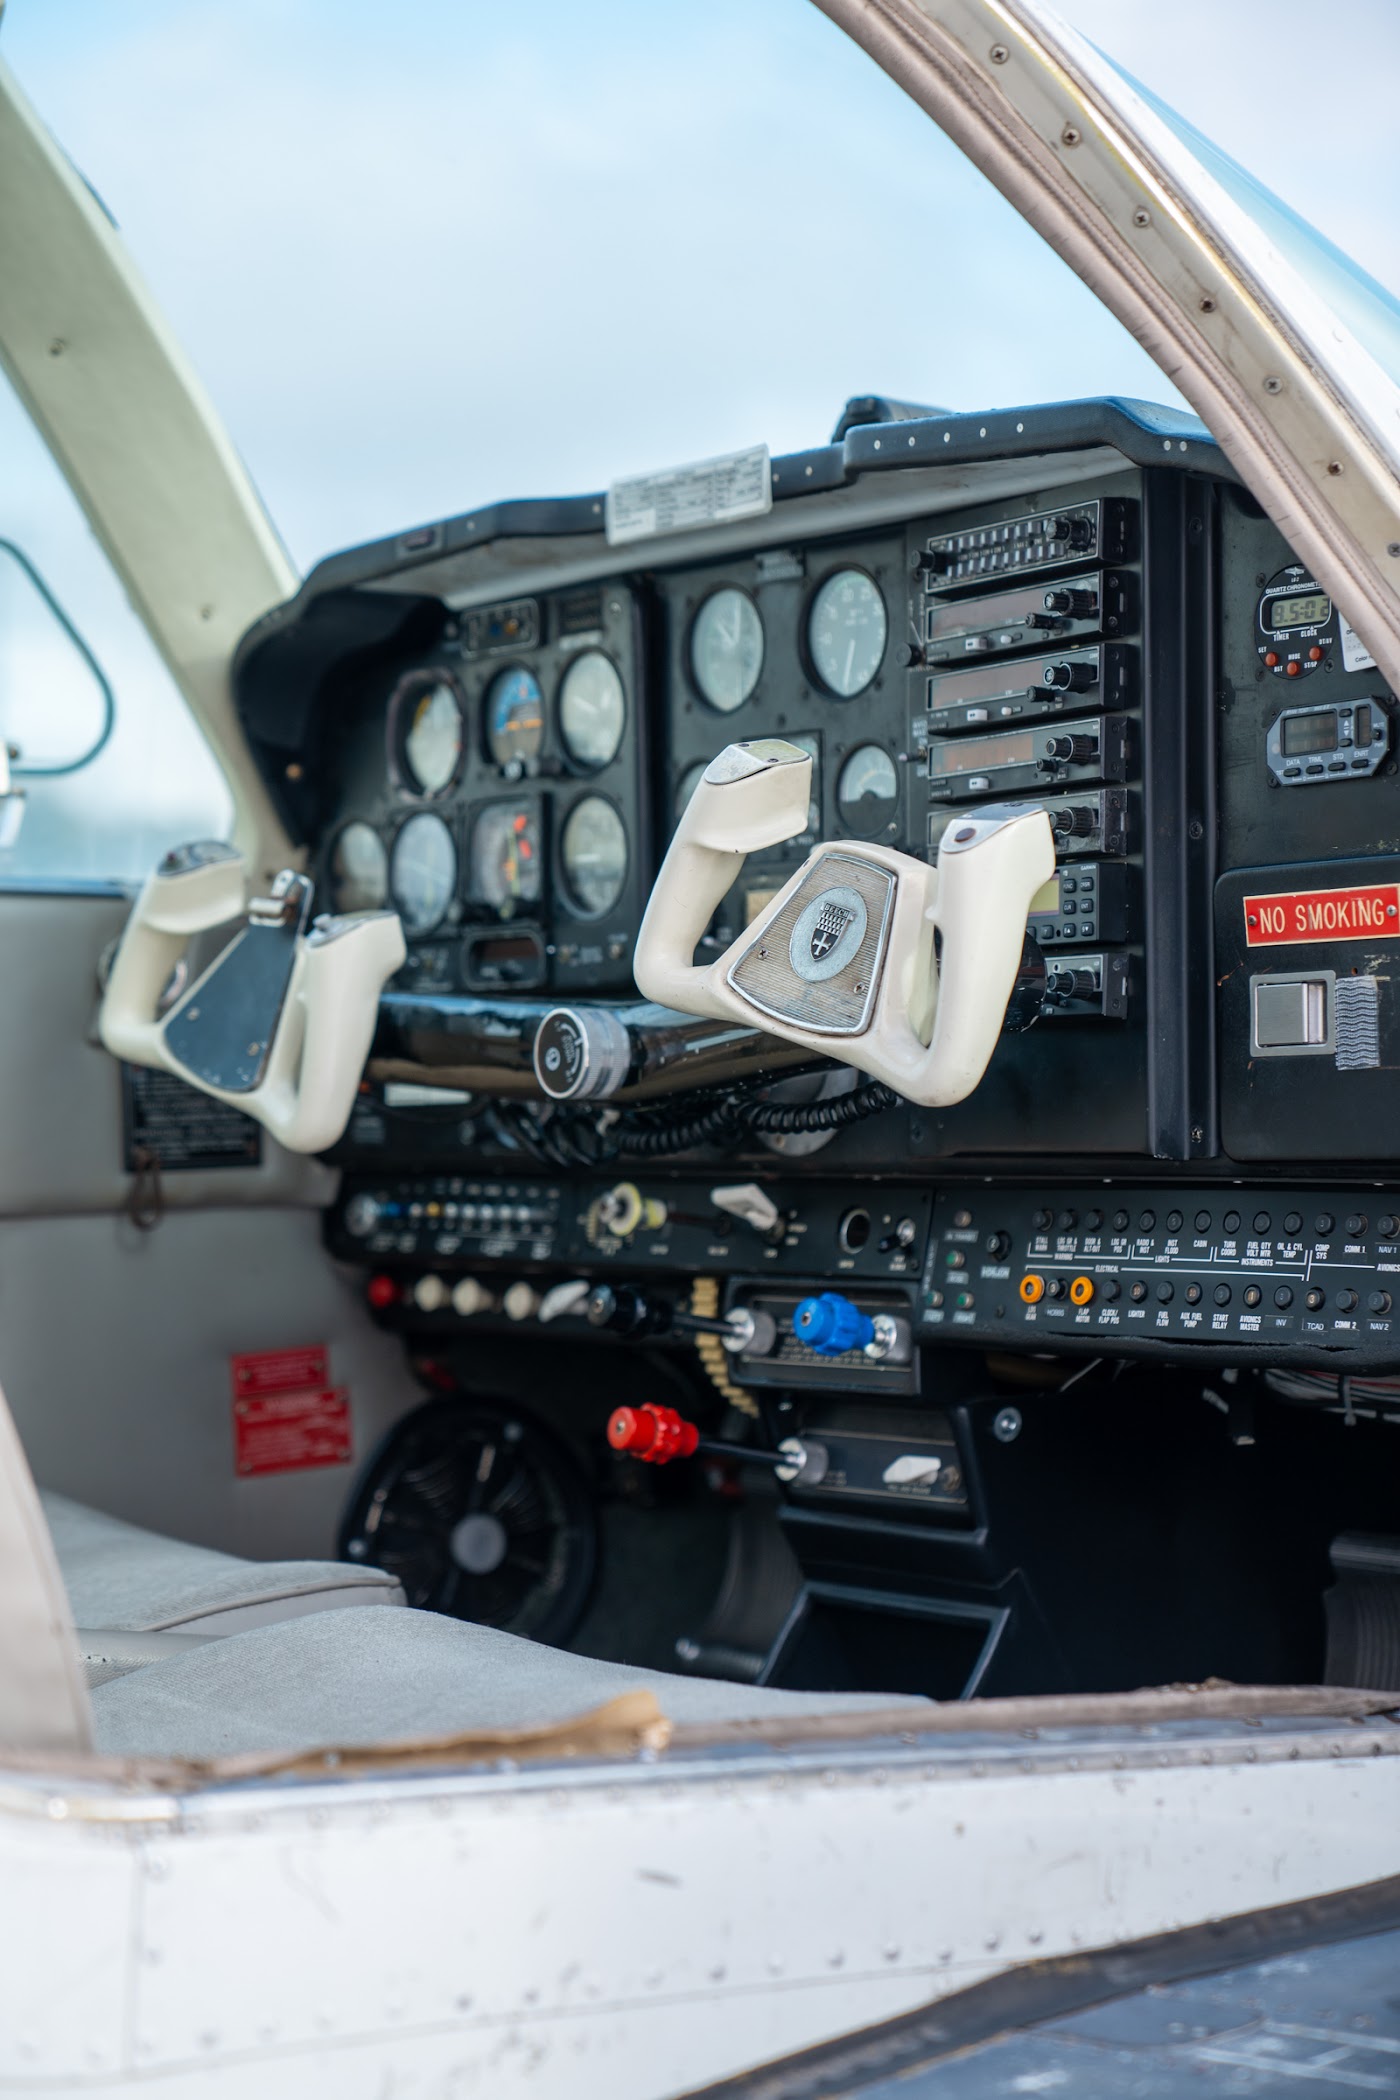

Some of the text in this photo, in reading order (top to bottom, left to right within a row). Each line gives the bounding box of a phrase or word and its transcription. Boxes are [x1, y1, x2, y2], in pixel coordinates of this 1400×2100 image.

[1265, 584, 1287, 594] QUARTZ
[1273, 633, 1289, 641] TIMER
[1300, 629, 1318, 638] CLOCK
[1258, 646, 1267, 654] SET
[1274, 665, 1283, 673] RST
[1333, 753, 1344, 761] STD
[1354, 749, 1369, 758] ENRT
[1286, 759, 1300, 767] DATA
[1308, 756, 1323, 764] TRML
[823, 902, 850, 918] BEECH
[1259, 898, 1385, 934] NO SMOKING
[1167, 1239, 1178, 1247] INST
[1193, 1240, 1208, 1248] CABIN
[1223, 1241, 1237, 1249] TURN
[1247, 1241, 1272, 1250] FUEL QTY
[1277, 1242, 1286, 1250] OIL
[1293, 1243, 1304, 1251] CYL
[1139, 1246, 1150, 1254] INST
[1165, 1247, 1179, 1255] FLOOD
[1315, 1243, 1330, 1252] COMP
[1344, 1245, 1366, 1253] COMM 1
[1393, 1246, 1397, 1254] 1
[1221, 1248, 1237, 1256] COORD
[1247, 1249, 1272, 1258] VOLT MTR
[1283, 1250, 1297, 1258] TEMP
[1316, 1252, 1327, 1260] SYS
[1155, 1255, 1170, 1263] LIGHTS
[1241, 1258, 1274, 1267] INSTRUMENTS
[1095, 1264, 1119, 1273] ELECTRICAL
[1377, 1263, 1400, 1272] AVIONICS
[1309, 1294, 1315, 1304] 3
[1101, 1308, 1119, 1316] CLOCK/
[1128, 1310, 1146, 1318] LIGHTER
[1158, 1311, 1169, 1319] FUEL
[1075, 1315, 1090, 1323] MOTOR
[1098, 1316, 1120, 1325] FLAP POS
[1180, 1312, 1203, 1321] AUX FUEL
[1213, 1314, 1229, 1322] START
[1240, 1315, 1261, 1323] AVIONICS
[1156, 1319, 1170, 1327] FLOW
[1184, 1320, 1198, 1328] PUMP
[1212, 1321, 1228, 1329] RELAY
[1240, 1323, 1260, 1331] MASTER
[1275, 1319, 1287, 1327] INV
[1307, 1322, 1325, 1331] TCAD
[1335, 1320, 1357, 1329] COMM 2
[1370, 1323, 1390, 1331] NAV 2
